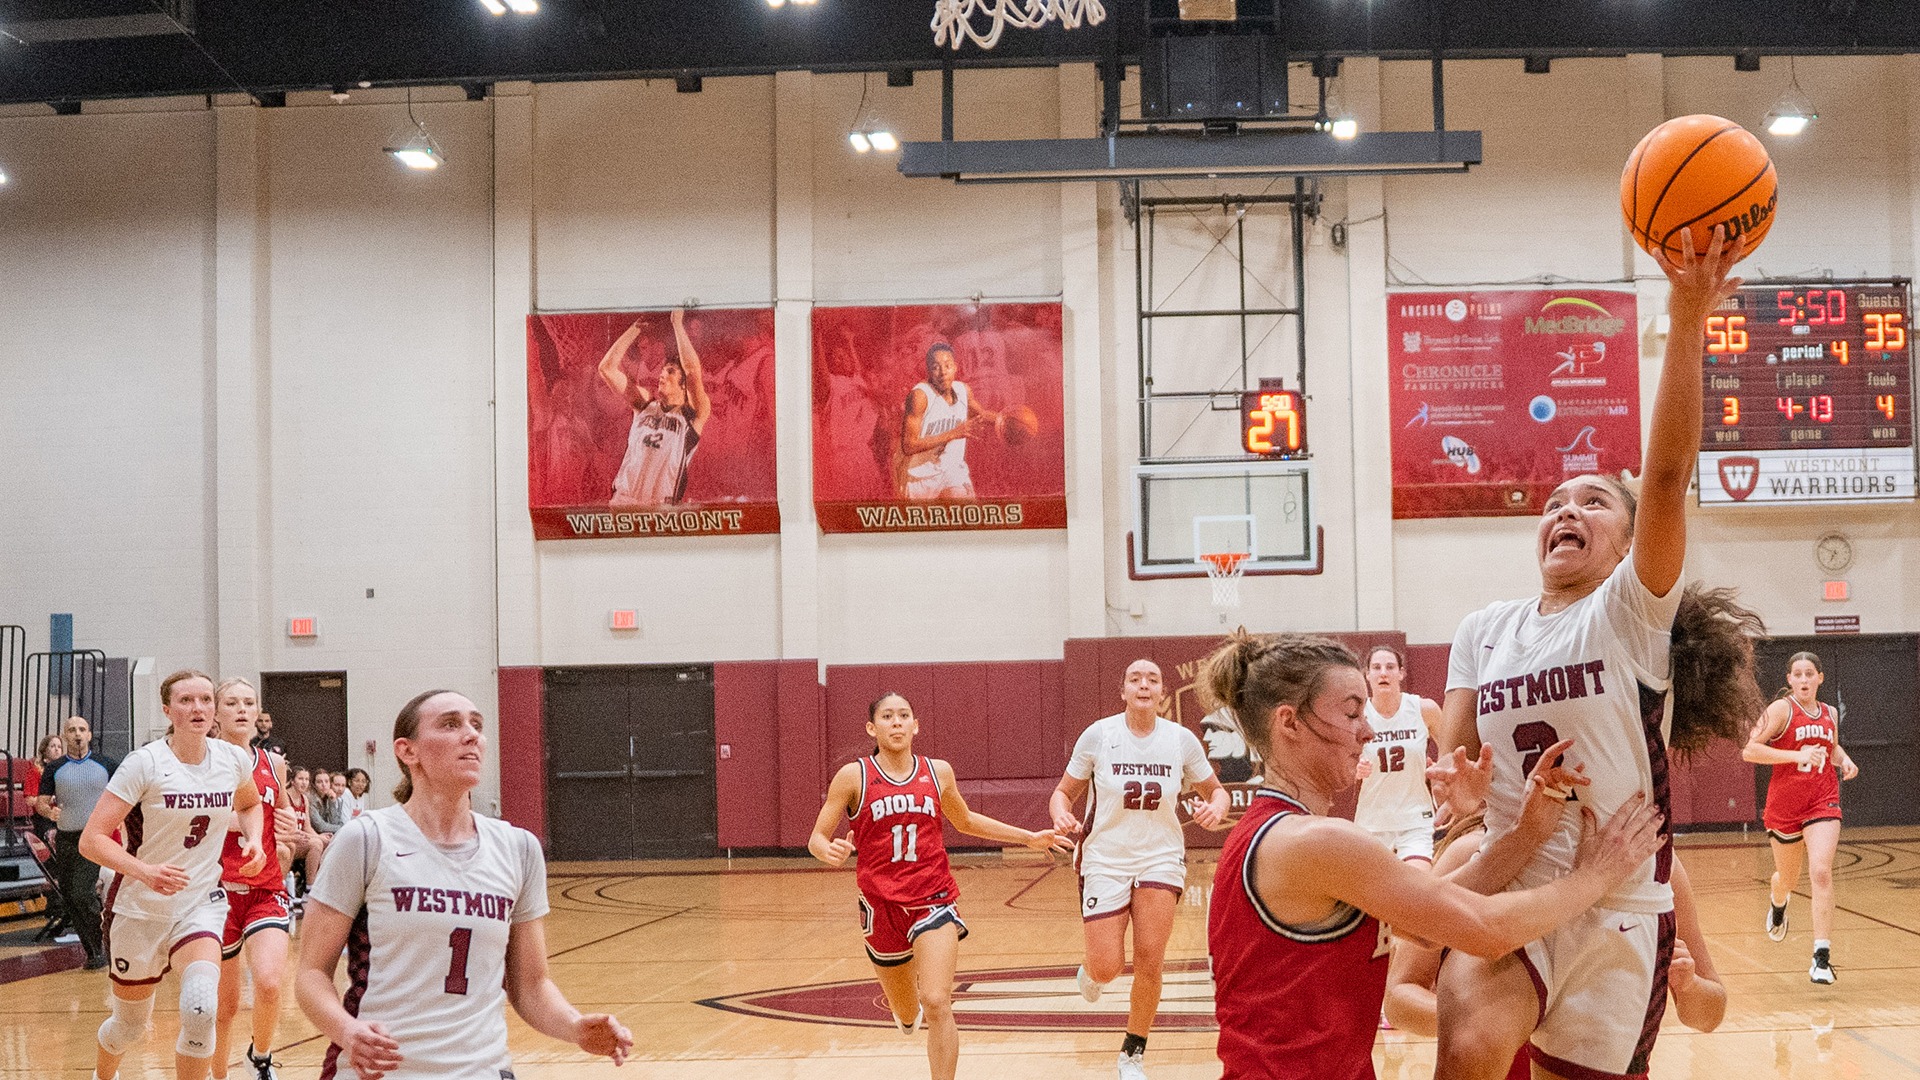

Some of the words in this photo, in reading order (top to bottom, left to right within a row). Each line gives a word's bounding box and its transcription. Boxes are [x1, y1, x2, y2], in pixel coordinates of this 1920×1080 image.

[1707, 183, 1778, 244] Wilso
[1777, 290, 1846, 325] 5:50
[1858, 293, 1901, 309] Guests
[1524, 315, 1625, 337] MedBridge
[1705, 316, 1749, 355] 56
[1863, 313, 1906, 351] 35
[1782, 343, 1824, 362] period
[1831, 340, 1850, 365] 4
[1402, 364, 1503, 379] CHRONICLE
[1785, 372, 1825, 393] player
[1868, 371, 1897, 391] fouls
[1711, 374, 1740, 395] fouls
[1723, 396, 1741, 426] 3
[1875, 394, 1895, 421] 4
[643, 432, 664, 449] 42
[1248, 410, 1300, 454] 27
[1715, 430, 1740, 442] won
[1790, 428, 1822, 443] game
[1872, 427, 1897, 439] won
[1447, 447, 1474, 456] HUB
[1784, 457, 1881, 474] WESTMONT
[1769, 475, 1897, 496] WARRIORS
[566, 509, 743, 534] WESTMONT
[856, 503, 1023, 528] WARRIORS
[292, 619, 313, 634] EXIT
[1478, 659, 1605, 716] ESTMONT
[1366, 729, 1418, 743] ESTMONT
[1795, 724, 1834, 744] BIOLA
[1111, 763, 1172, 778] WESTMONT
[1377, 745, 1406, 773] 12
[1123, 780, 1162, 811] 22
[870, 794, 936, 822] BIOLA
[183, 814, 211, 849] 3
[890, 823, 918, 863] 11
[444, 927, 473, 995] 1
